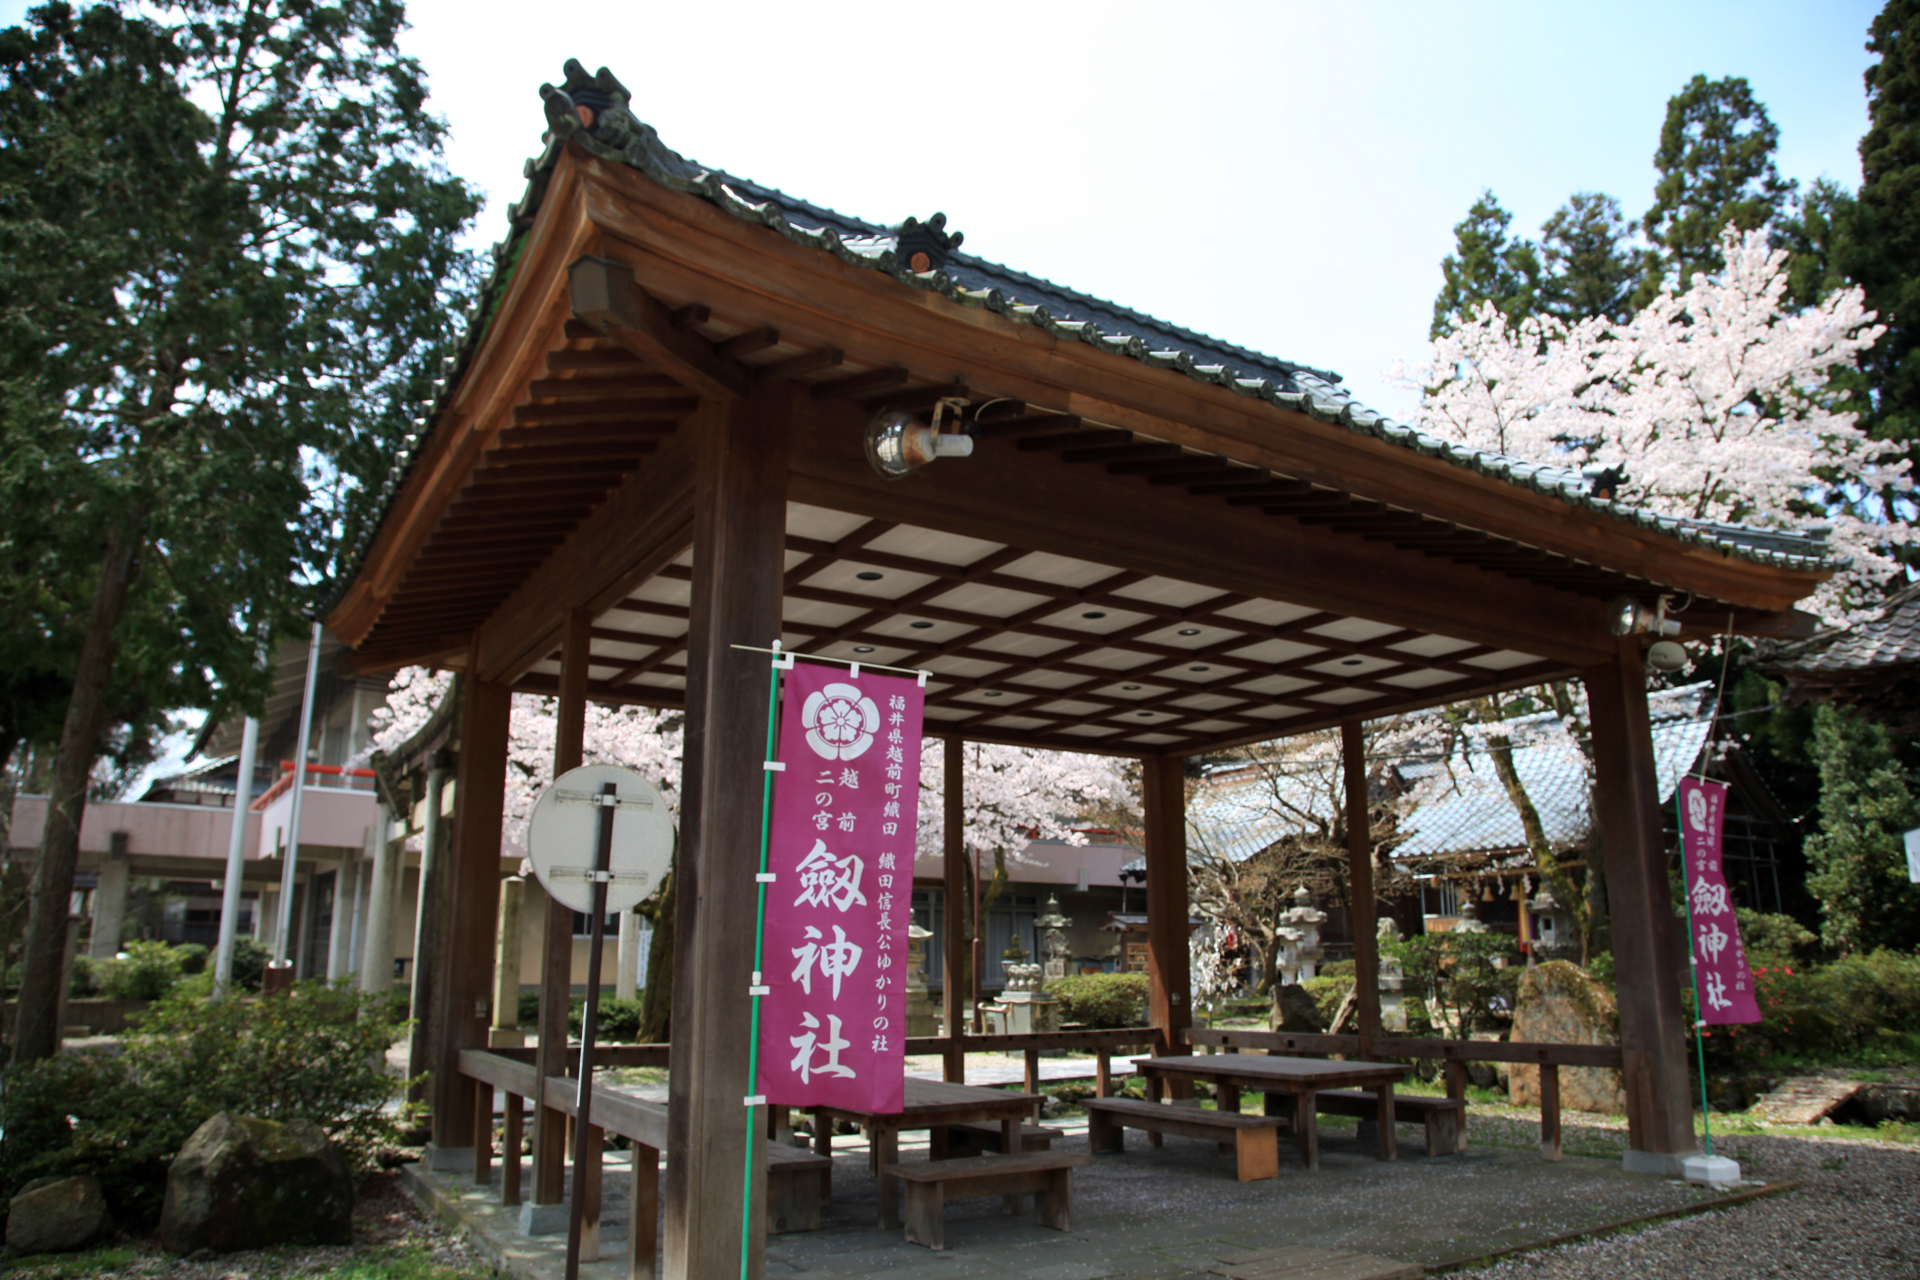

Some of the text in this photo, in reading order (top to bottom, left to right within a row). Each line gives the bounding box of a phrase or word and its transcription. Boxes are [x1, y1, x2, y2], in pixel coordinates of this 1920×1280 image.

[812, 769, 835, 831] 二の宮
[836, 767, 860, 833] 越前
[871, 694, 906, 1053] 福井県越前町織田 織田信長公ゆかりの社
